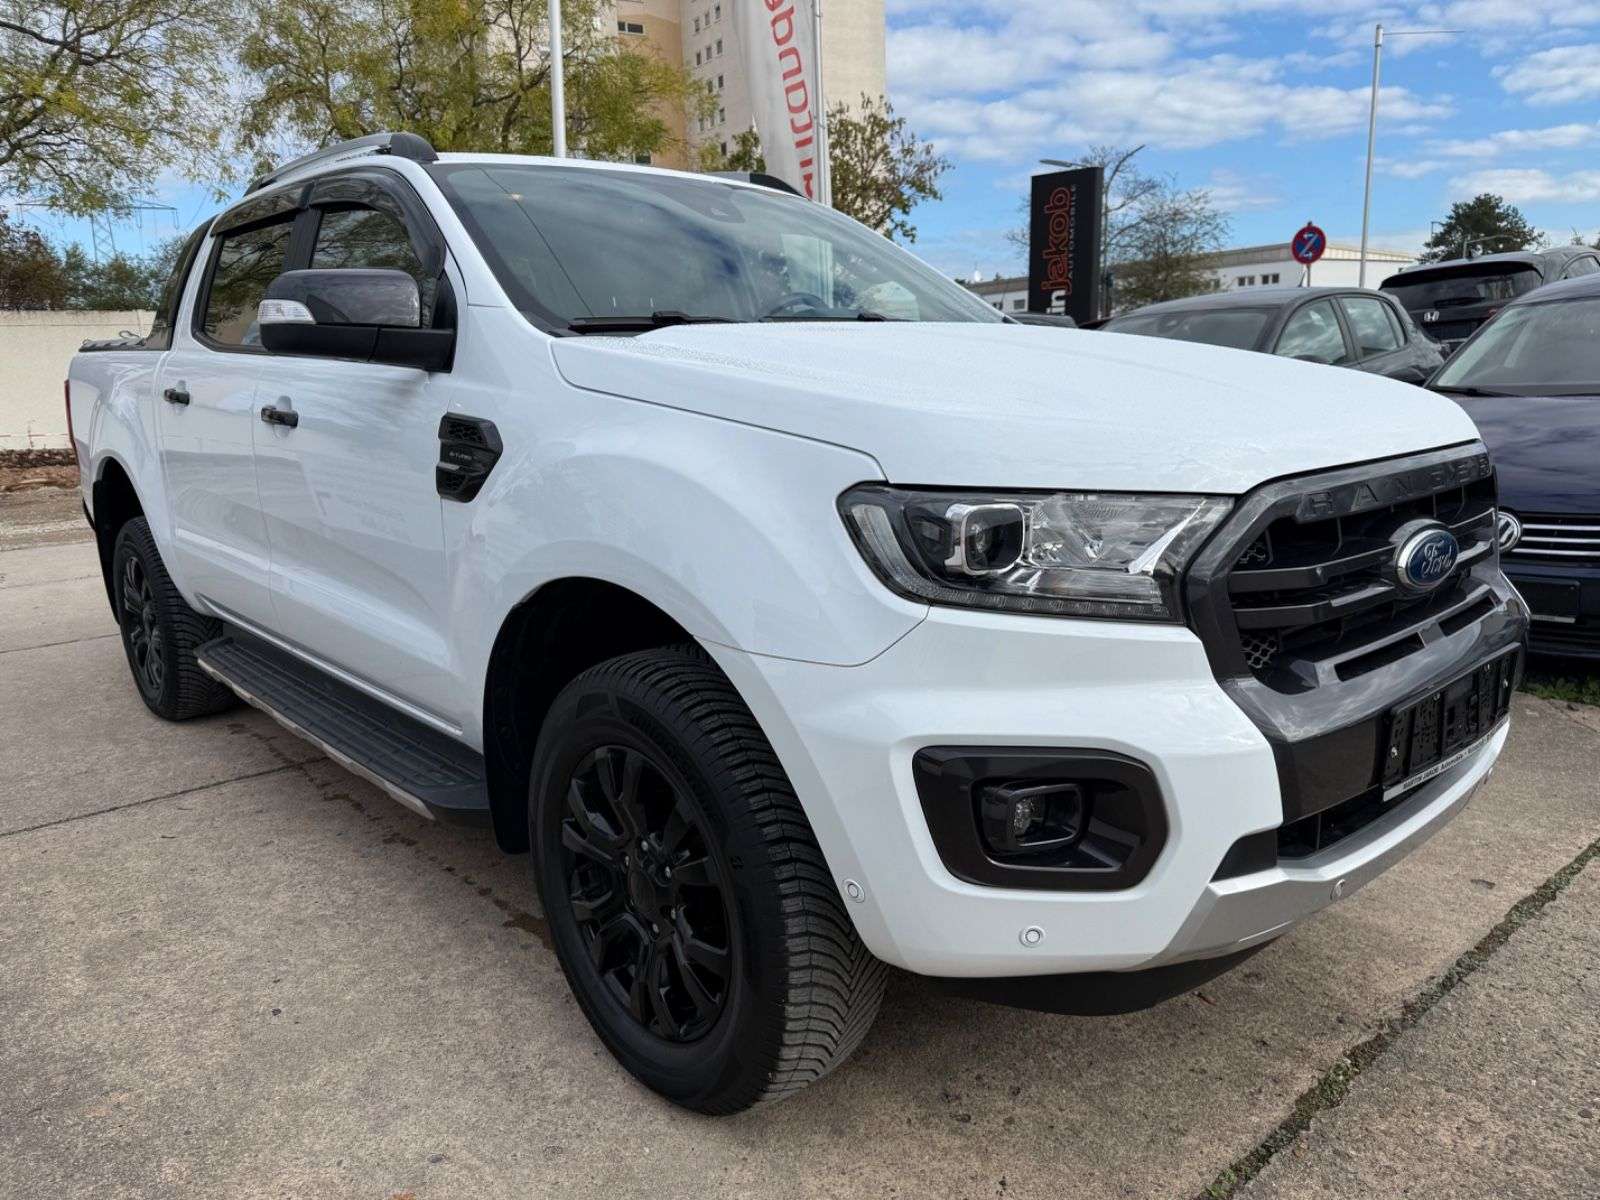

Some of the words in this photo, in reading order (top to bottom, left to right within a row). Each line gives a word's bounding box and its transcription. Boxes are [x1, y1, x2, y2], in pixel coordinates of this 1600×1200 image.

[1041, 187, 1072, 296] jakob
[1305, 455, 1491, 517] RANGER
[1420, 539, 1452, 576] Ford
